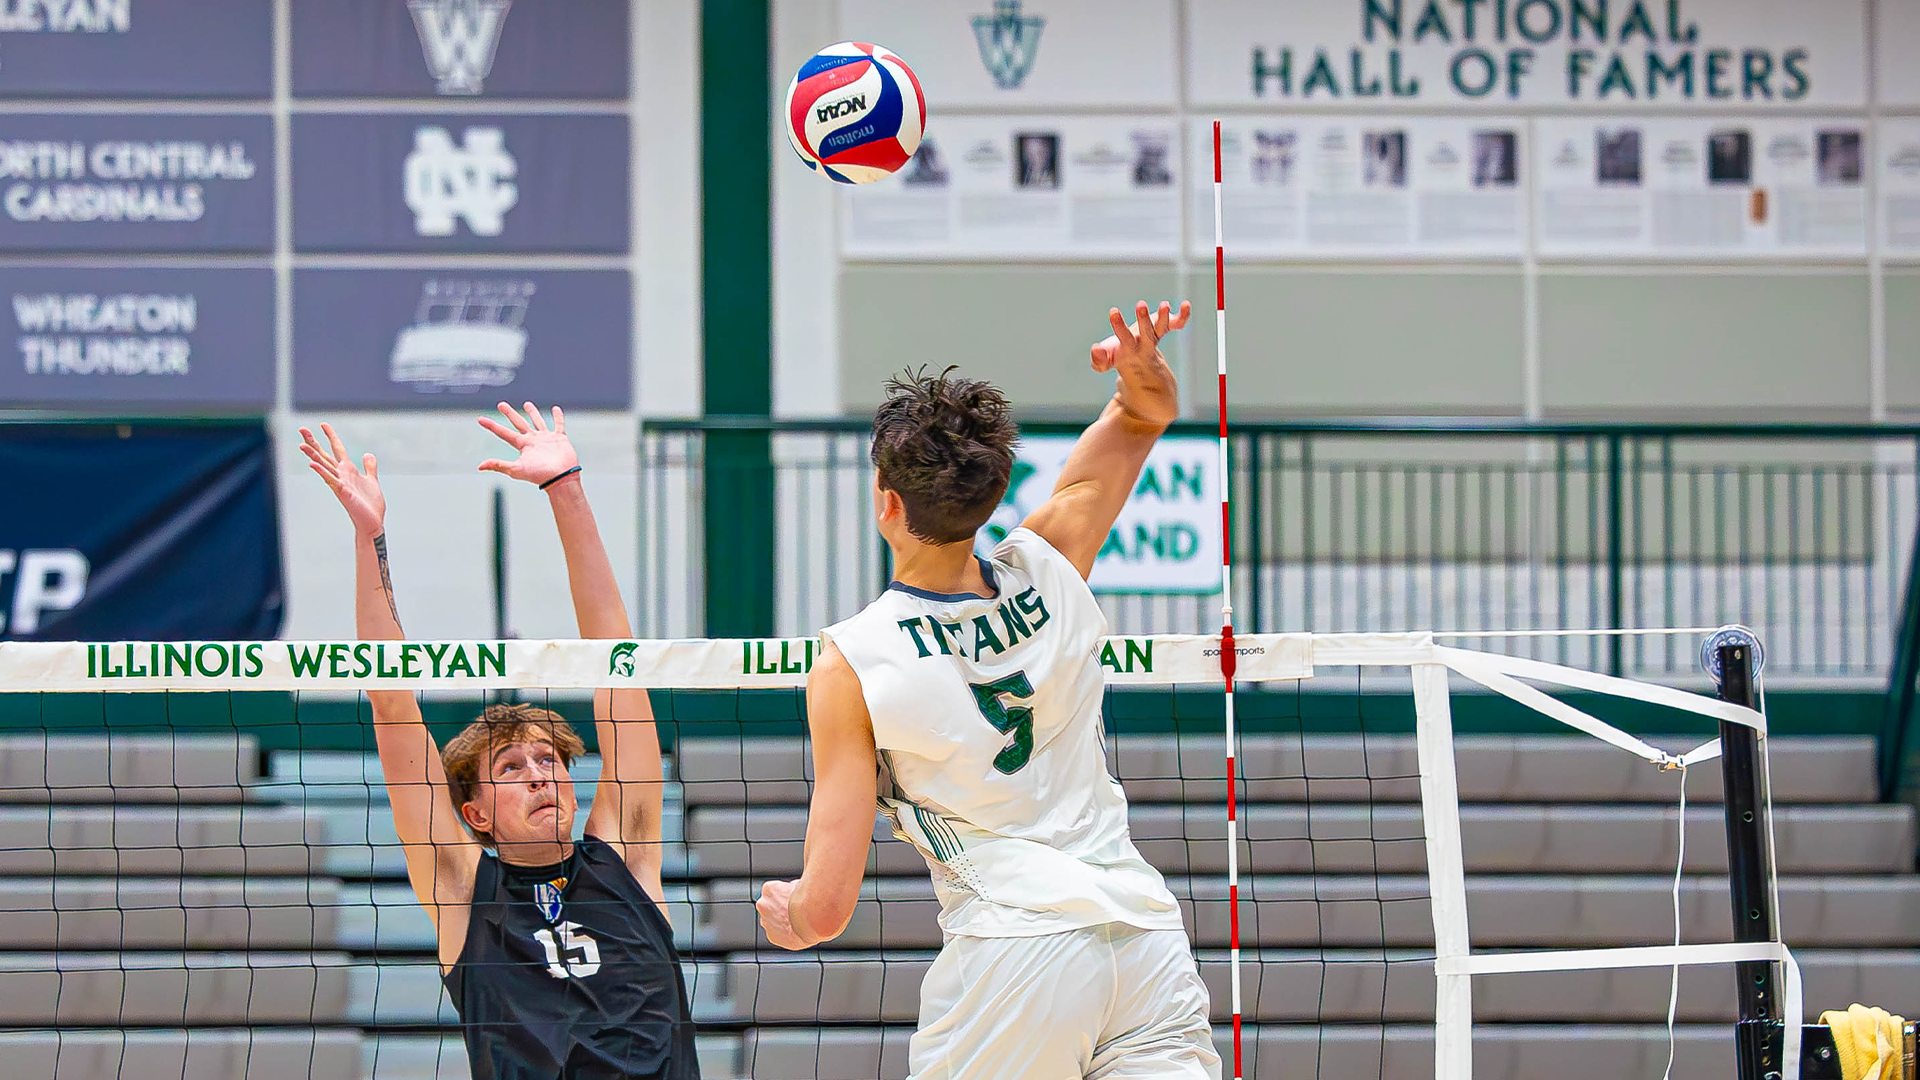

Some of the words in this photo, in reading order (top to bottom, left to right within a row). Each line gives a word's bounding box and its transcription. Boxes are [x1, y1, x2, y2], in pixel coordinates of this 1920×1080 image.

[1361, 0, 1700, 44] NATIONAL
[1252, 46, 1419, 97] HALL
[1449, 47, 1535, 98] OF
[1567, 47, 1811, 99] FAMERS
[816, 94, 867, 124] NCAA
[828, 123, 875, 147] molten
[90, 141, 256, 180] CENTRAL
[4, 182, 205, 222] CARDINALS
[12, 294, 198, 333] WHEATON
[18, 336, 191, 375] THUNDER
[1097, 522, 1199, 562] AND
[897, 584, 1052, 664] TITANS
[87, 642, 265, 679] ILLINOIS
[287, 642, 508, 679] WESLEYAN
[743, 640, 821, 675] ILLI
[1235, 647, 1265, 656] mports
[968, 669, 1036, 776] 5
[532, 920, 602, 980] 15
